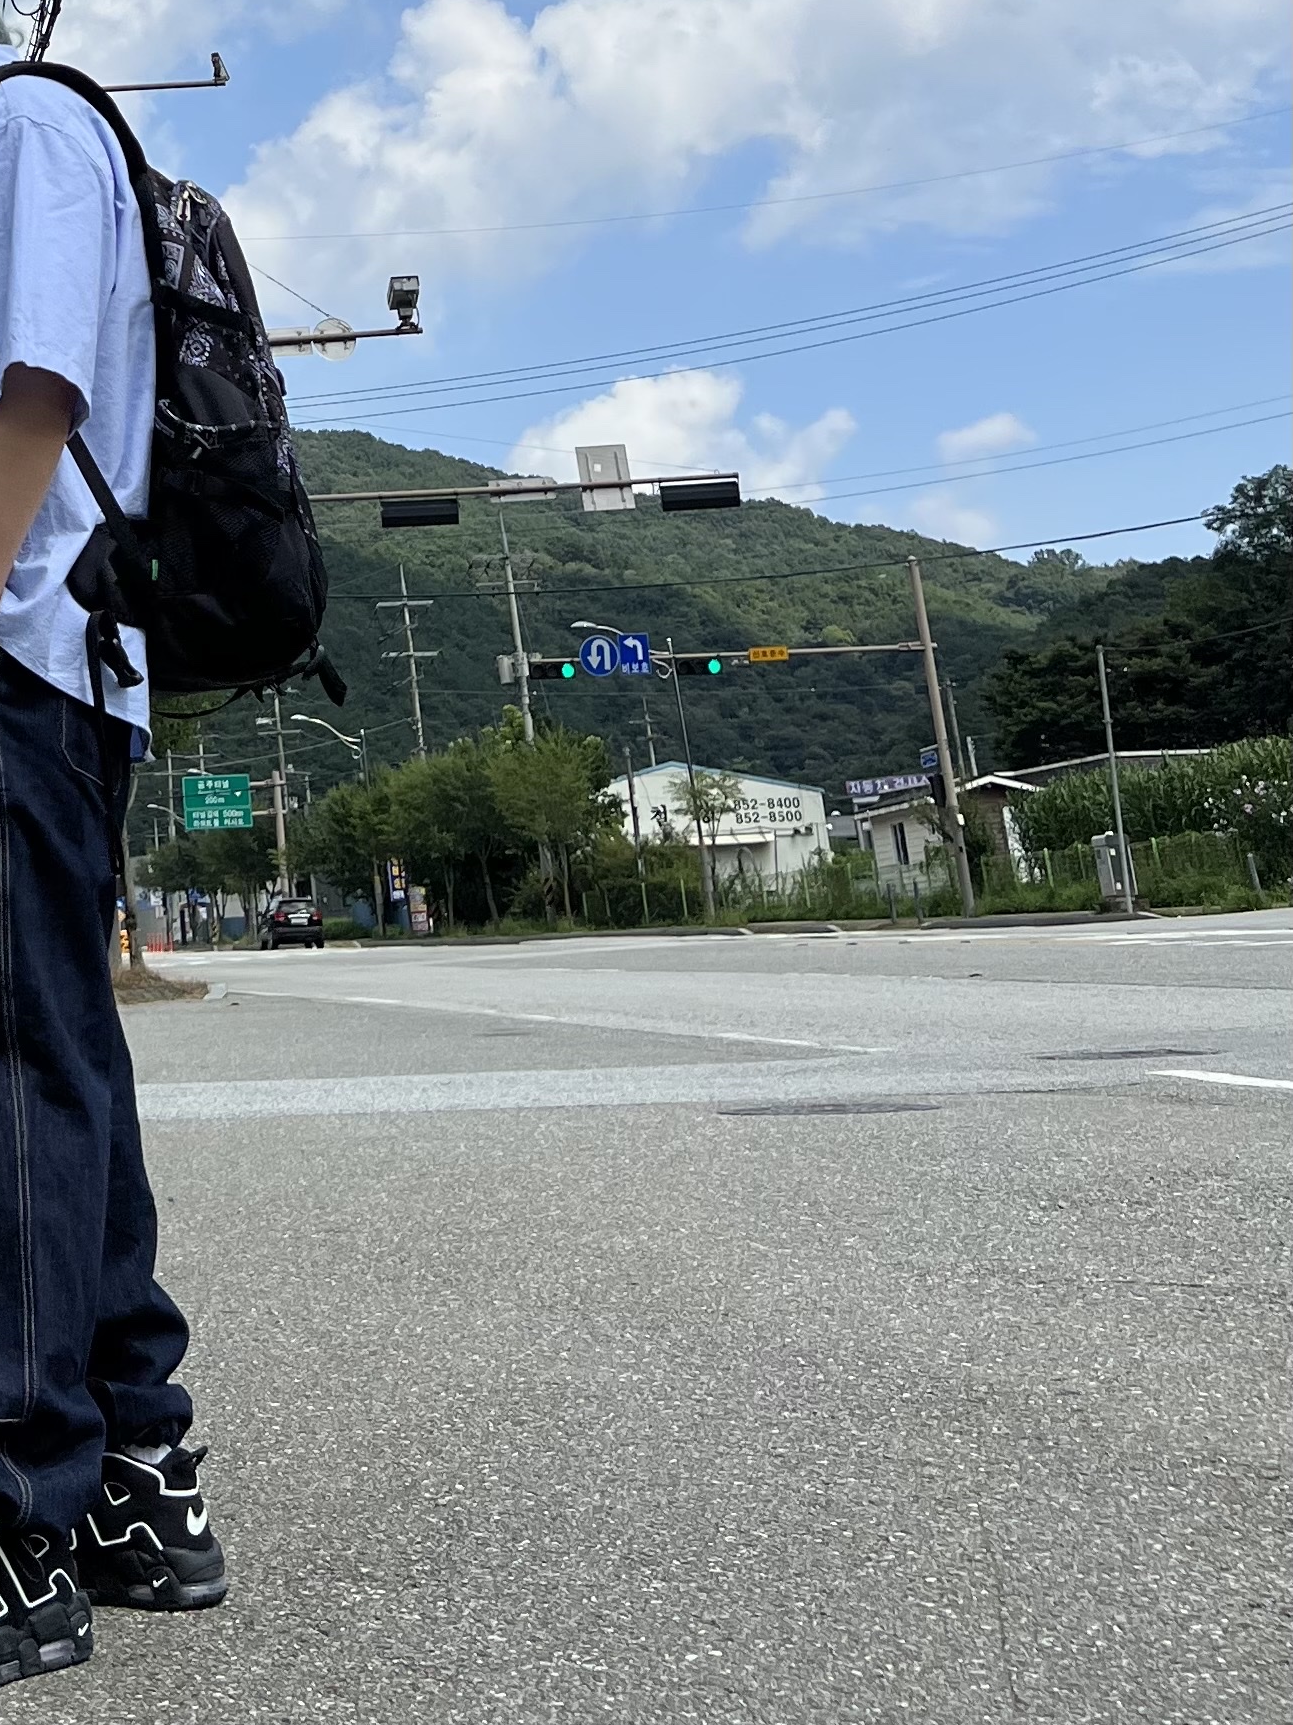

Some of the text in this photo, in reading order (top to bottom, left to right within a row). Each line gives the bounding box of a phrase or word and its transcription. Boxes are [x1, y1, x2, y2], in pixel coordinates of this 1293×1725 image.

[622, 662, 649, 674] 비보호
[734, 797, 800, 811] 852-8400
[735, 810, 802, 824] 852-8500
